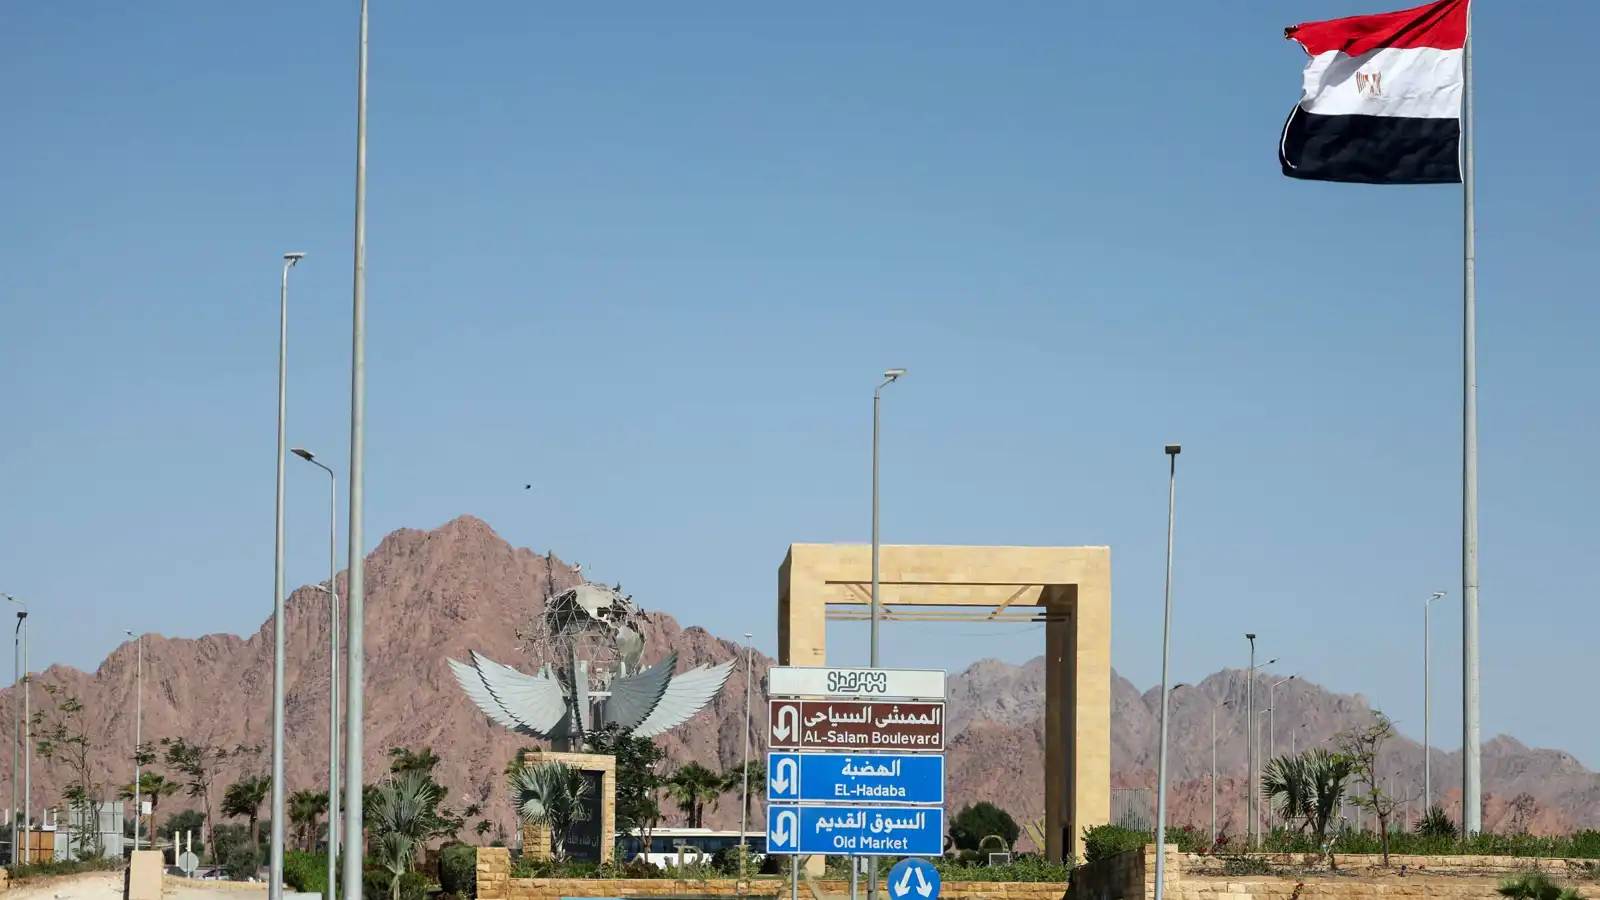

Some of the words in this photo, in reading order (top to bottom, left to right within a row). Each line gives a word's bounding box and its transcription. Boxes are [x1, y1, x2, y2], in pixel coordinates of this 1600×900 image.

[875, 705, 940, 728] الممشى
[804, 730, 869, 744] AL-Salam
[871, 731, 940, 745] Boulevard
[841, 758, 901, 780] الهضبة
[834, 783, 906, 797] EL-Hadaba
[815, 811, 867, 834] القديم
[869, 811, 925, 834] السوق
[833, 835, 857, 849] Old
[860, 836, 908, 849] Market
